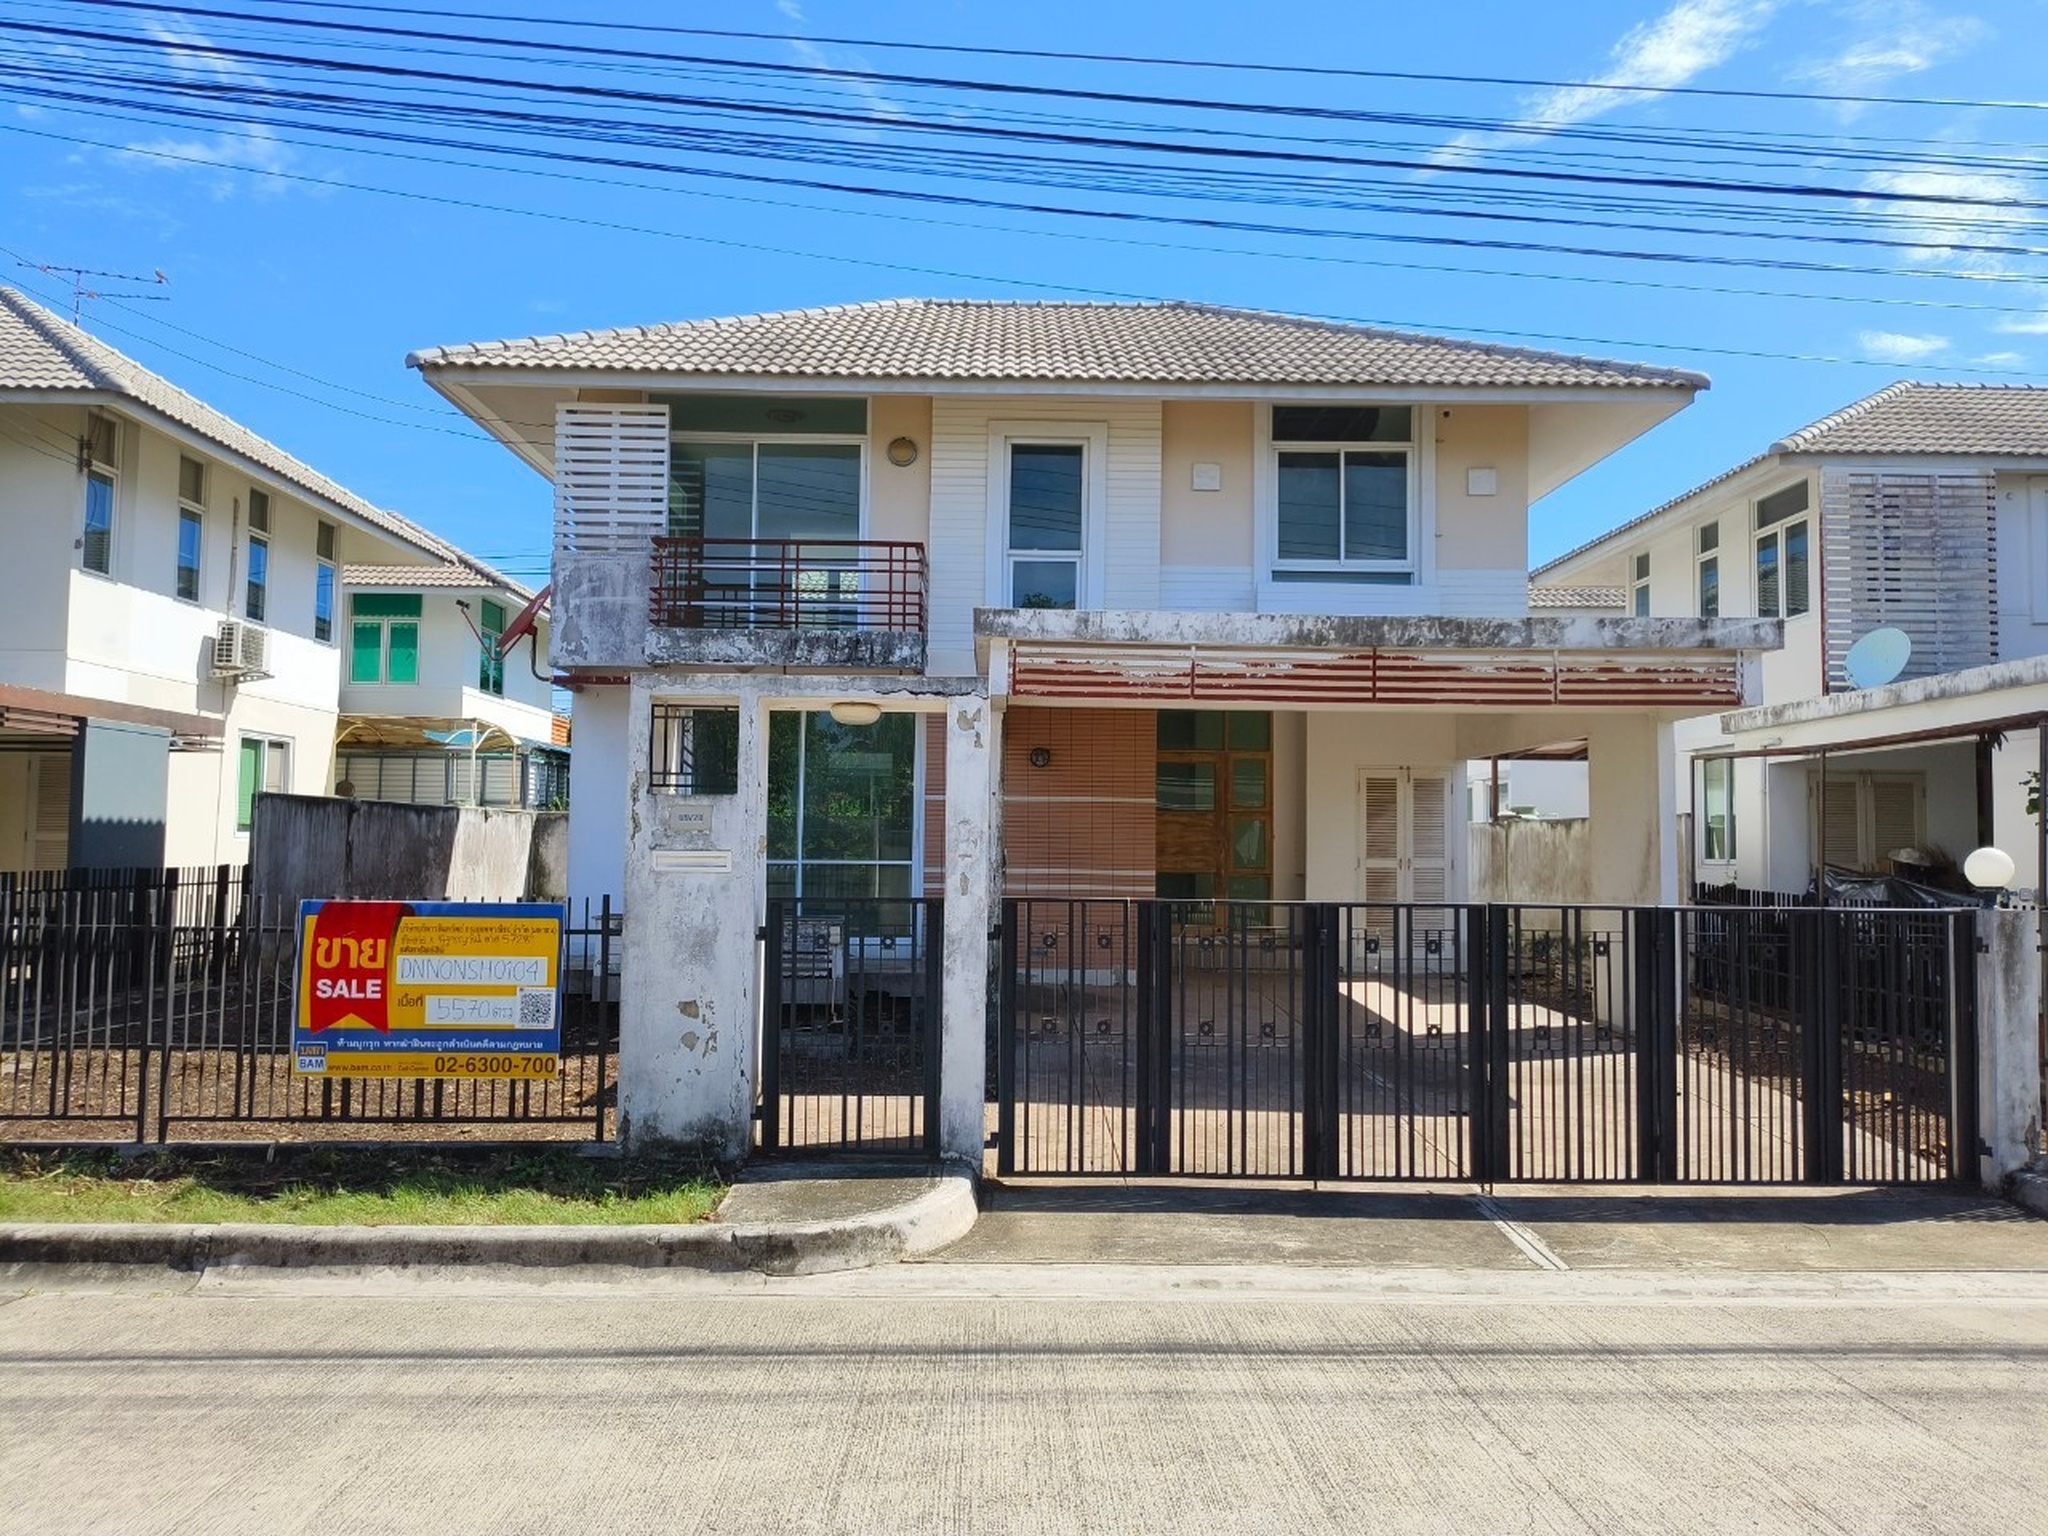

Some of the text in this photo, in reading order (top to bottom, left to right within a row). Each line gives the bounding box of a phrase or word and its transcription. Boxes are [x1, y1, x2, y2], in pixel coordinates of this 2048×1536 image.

[316, 937, 386, 968] ขาย
[316, 978, 382, 999] SALE
[300, 1058, 325, 1069] BAM
[434, 1056, 556, 1074] 02-6300-700
